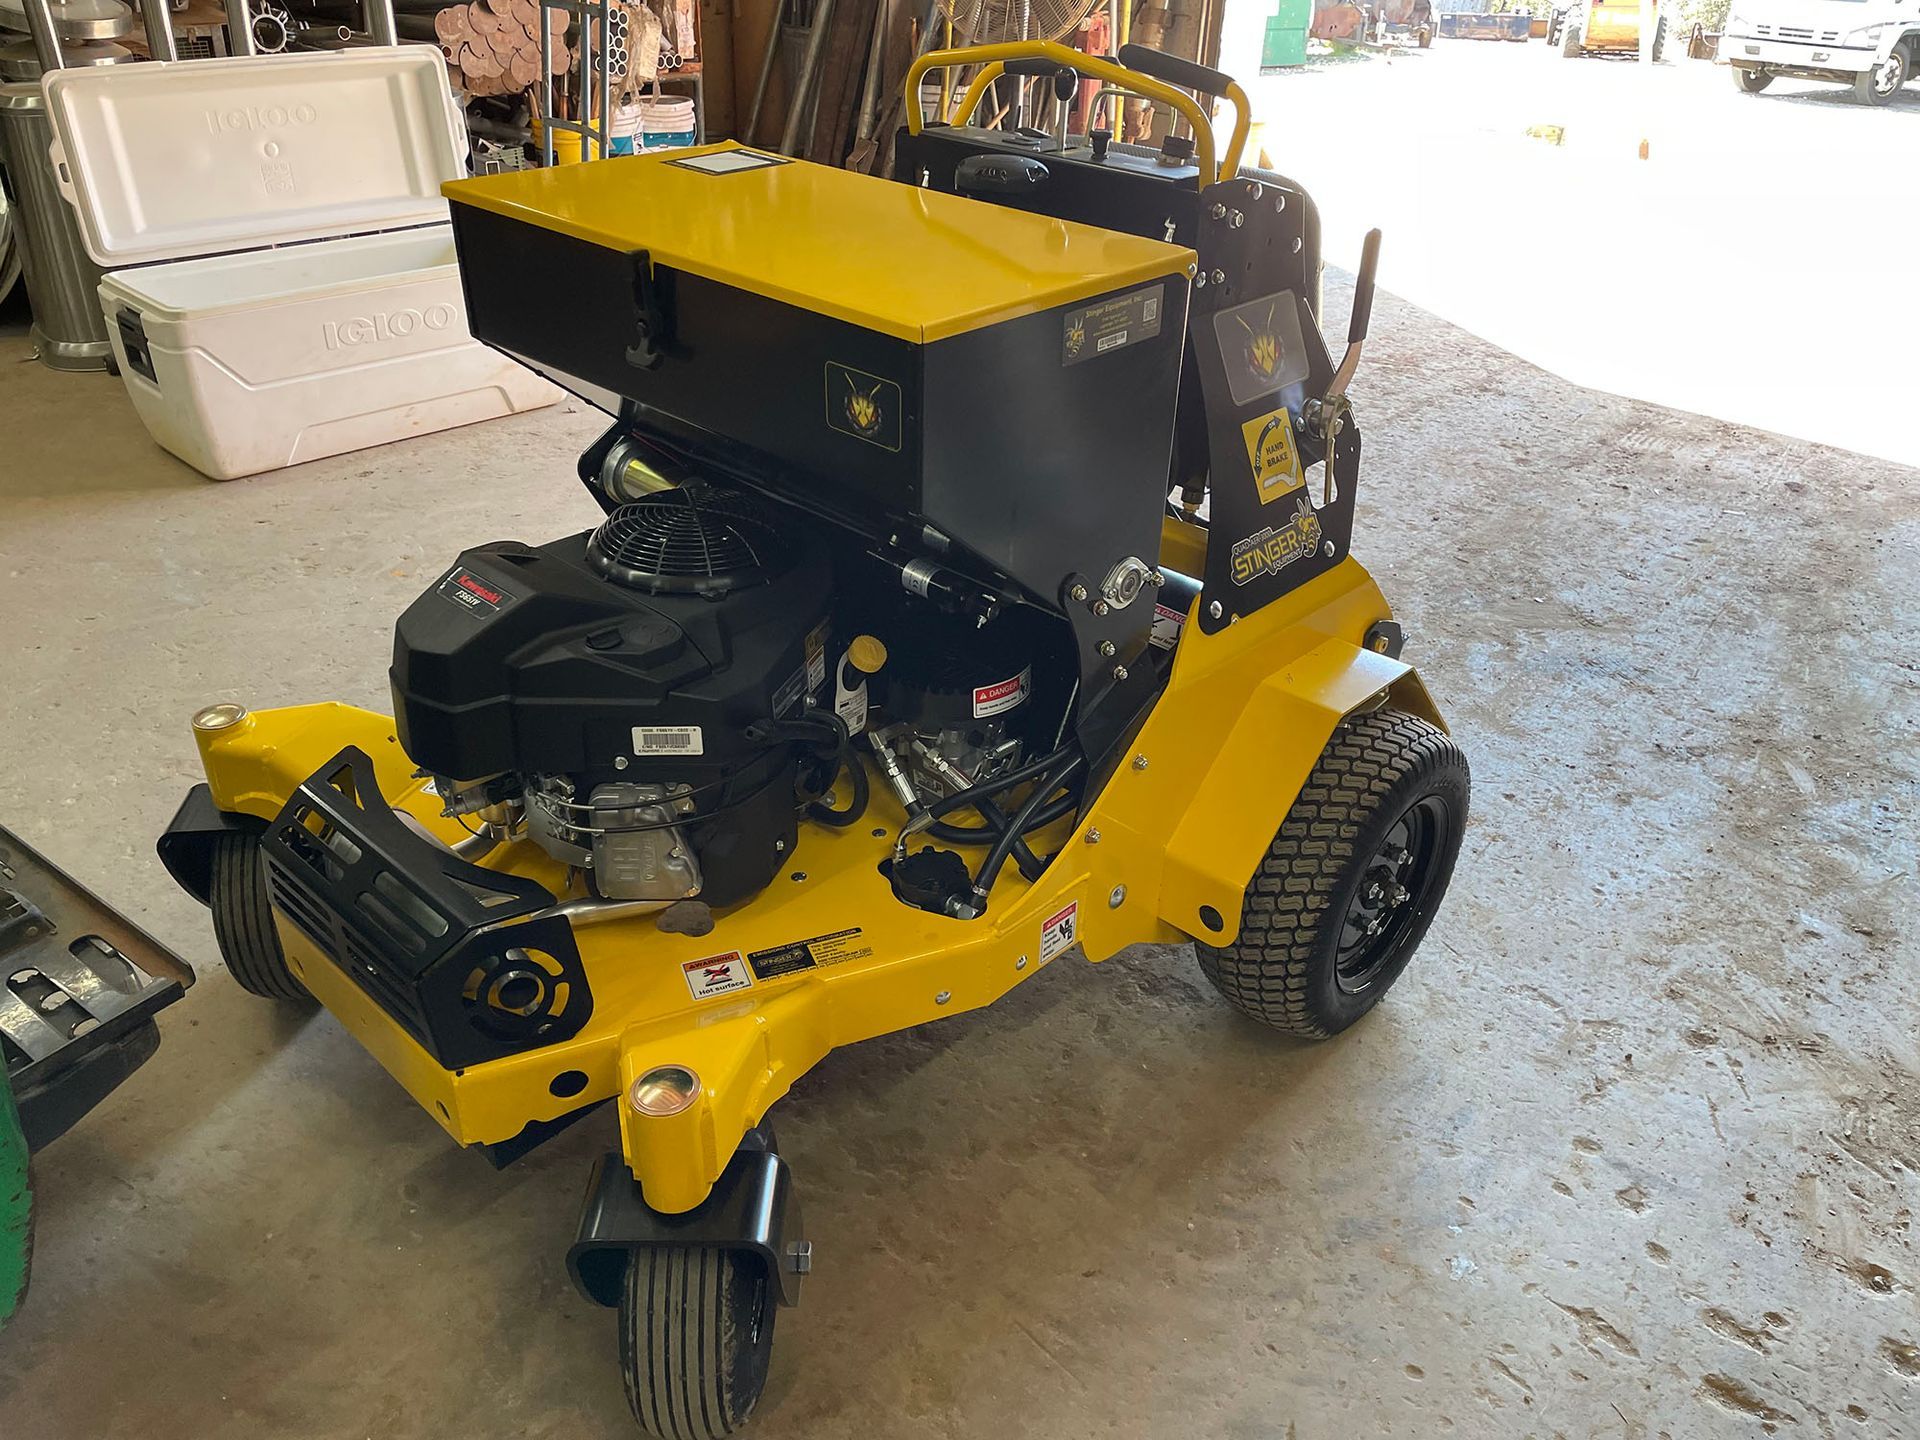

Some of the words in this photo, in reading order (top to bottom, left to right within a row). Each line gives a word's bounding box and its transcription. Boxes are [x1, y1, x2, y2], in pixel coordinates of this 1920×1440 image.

[205, 103, 317, 136] IGLOO
[322, 302, 458, 351] IGLOO
[1265, 440, 1284, 456] HAND
[1266, 451, 1288, 468] BRAKE
[1235, 529, 1299, 579] STINGER
[1272, 547, 1302, 569] EQUIPMENT
[457, 574, 503, 605] Kawasaki
[1162, 608, 1187, 625] DANG
[989, 680, 1018, 698] DANGER
[1050, 906, 1073, 926] DANGER
[696, 954, 735, 969] WARNING
[698, 987, 715, 997] Hot
[714, 980, 745, 994] surface
